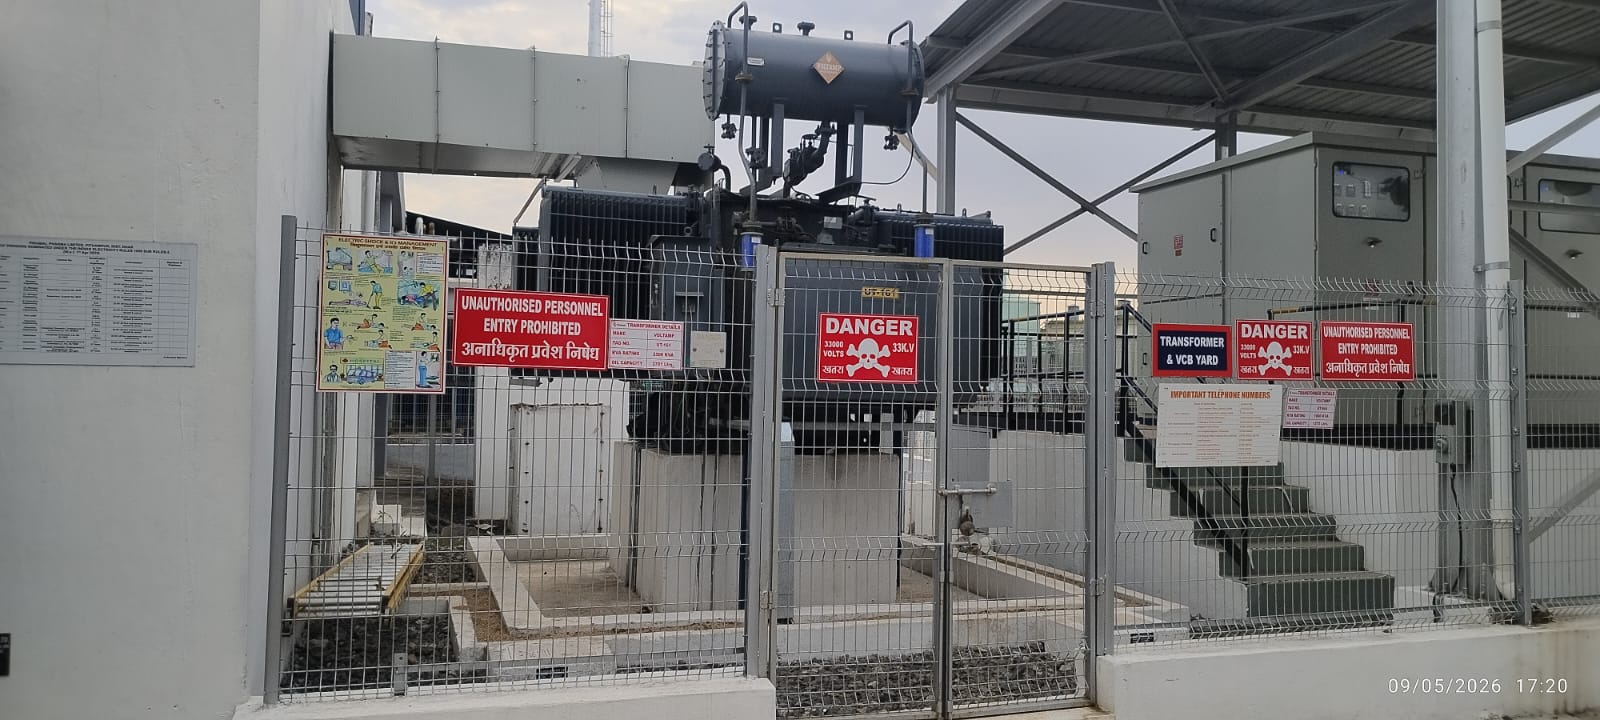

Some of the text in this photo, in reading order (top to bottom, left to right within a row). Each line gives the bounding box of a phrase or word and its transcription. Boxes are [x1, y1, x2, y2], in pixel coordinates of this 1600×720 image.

[461, 296, 603, 316] UNAUTHORISED PERSONNEL
[484, 318, 581, 336] ENTRY PROHIBITED
[826, 318, 913, 336] DANGER
[1241, 324, 1308, 339] DANGER
[1324, 326, 1410, 339] UNAUTHORISED PERSONNEL
[893, 343, 914, 353] 33K.V
[1160, 336, 1224, 348] TRANSFORMER
[461, 338, 600, 362] अनाधिकृत प्रवेश निषेध
[1293, 345, 1310, 354] 33K.V
[1338, 343, 1398, 354] ENTRY PROHIBITED
[1166, 354, 1218, 365] & VCB YARD
[822, 366, 844, 374] खतरा
[891, 367, 913, 376] खतरा
[1240, 366, 1257, 374] खतरा
[1326, 358, 1410, 377] अनाधिकृत प्रवेश निषेध
